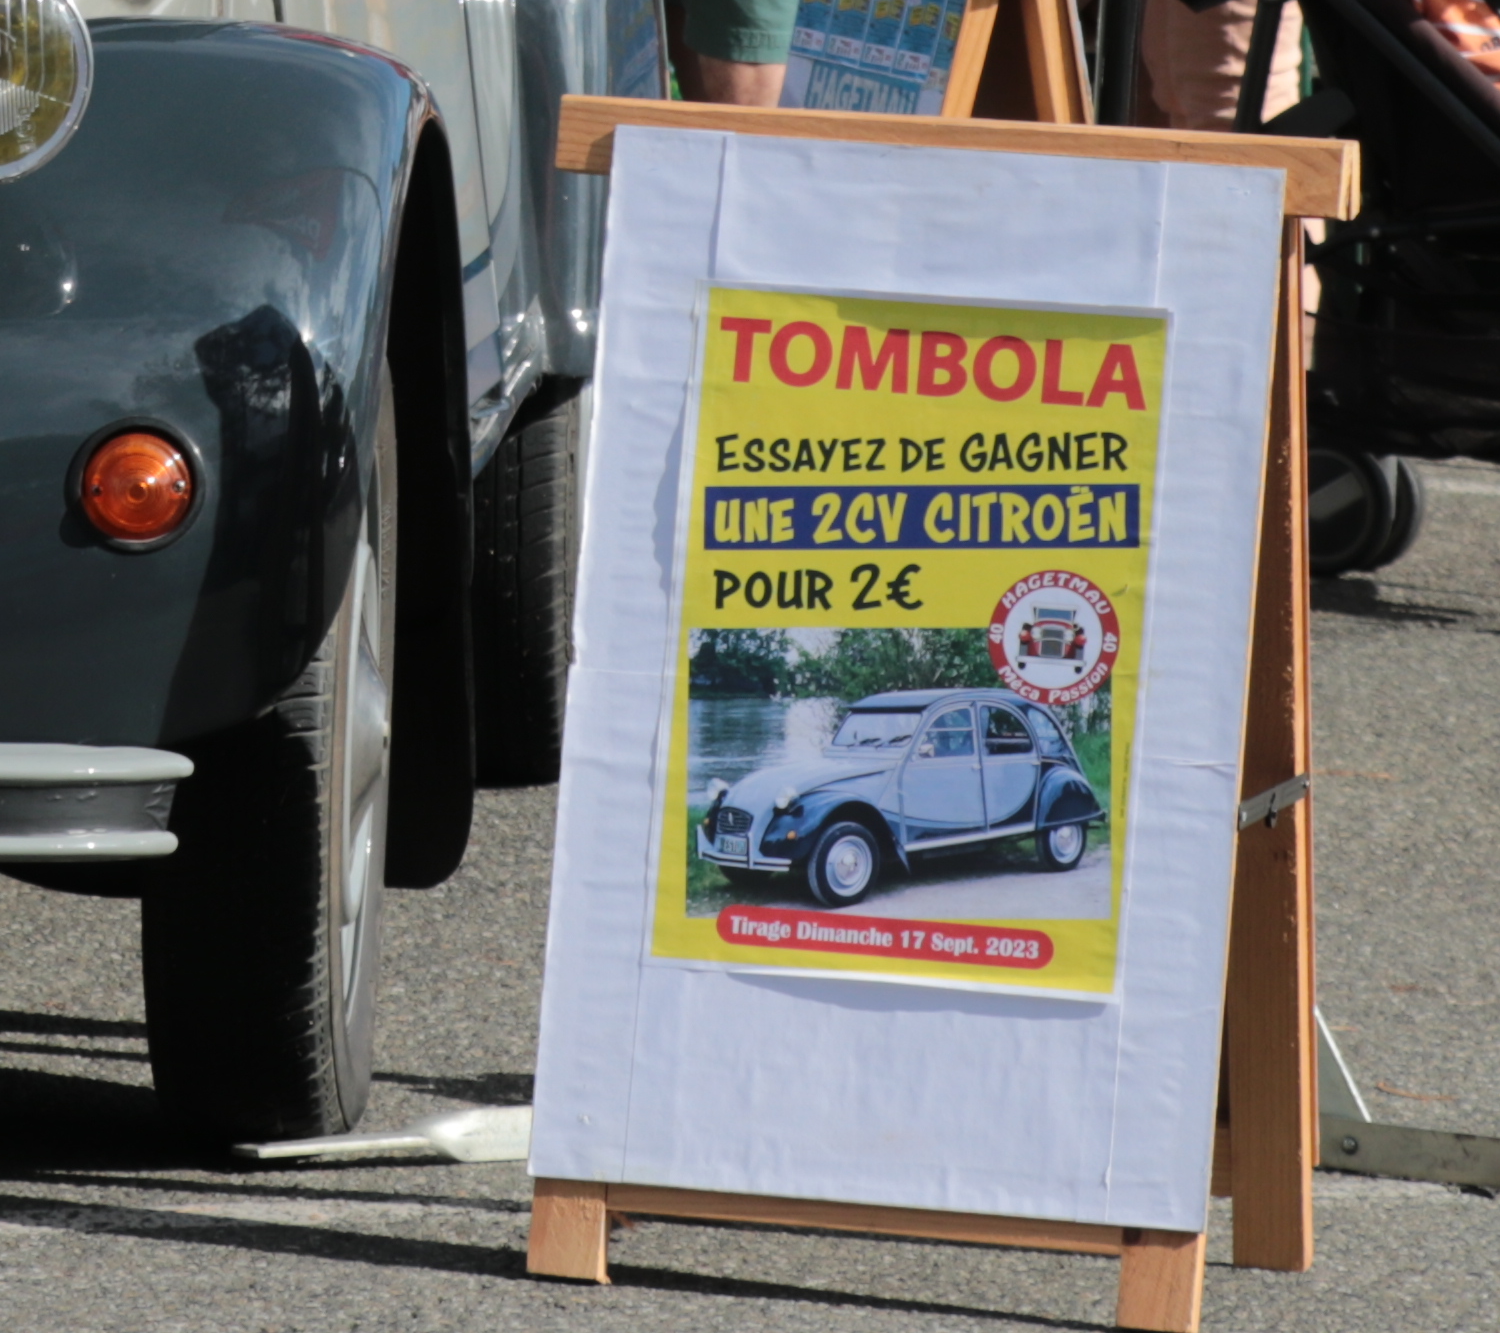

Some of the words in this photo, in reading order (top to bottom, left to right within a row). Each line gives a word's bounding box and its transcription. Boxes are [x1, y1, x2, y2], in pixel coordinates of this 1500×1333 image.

[720, 316, 1147, 411] TOMBOLA
[716, 433, 887, 473] ESSAYEZ
[900, 437, 946, 472] DE
[960, 432, 1129, 473] GAGNER
[714, 497, 795, 544] UNE
[811, 492, 908, 545] 2CV
[924, 486, 1127, 545] CITROËN
[714, 568, 833, 611] POUR
[850, 563, 924, 612] 2€
[1001, 572, 1111, 615] HAGETMAU
[989, 623, 1004, 644] 40
[1103, 632, 1118, 653] 40
[1048, 662, 1108, 703] Passion
[730, 915, 791, 941] Tirage
[796, 921, 893, 947] Dimanche
[900, 930, 925, 949] 17
[931, 933, 979, 956] Sept.
[985, 937, 1040, 959] 2023
